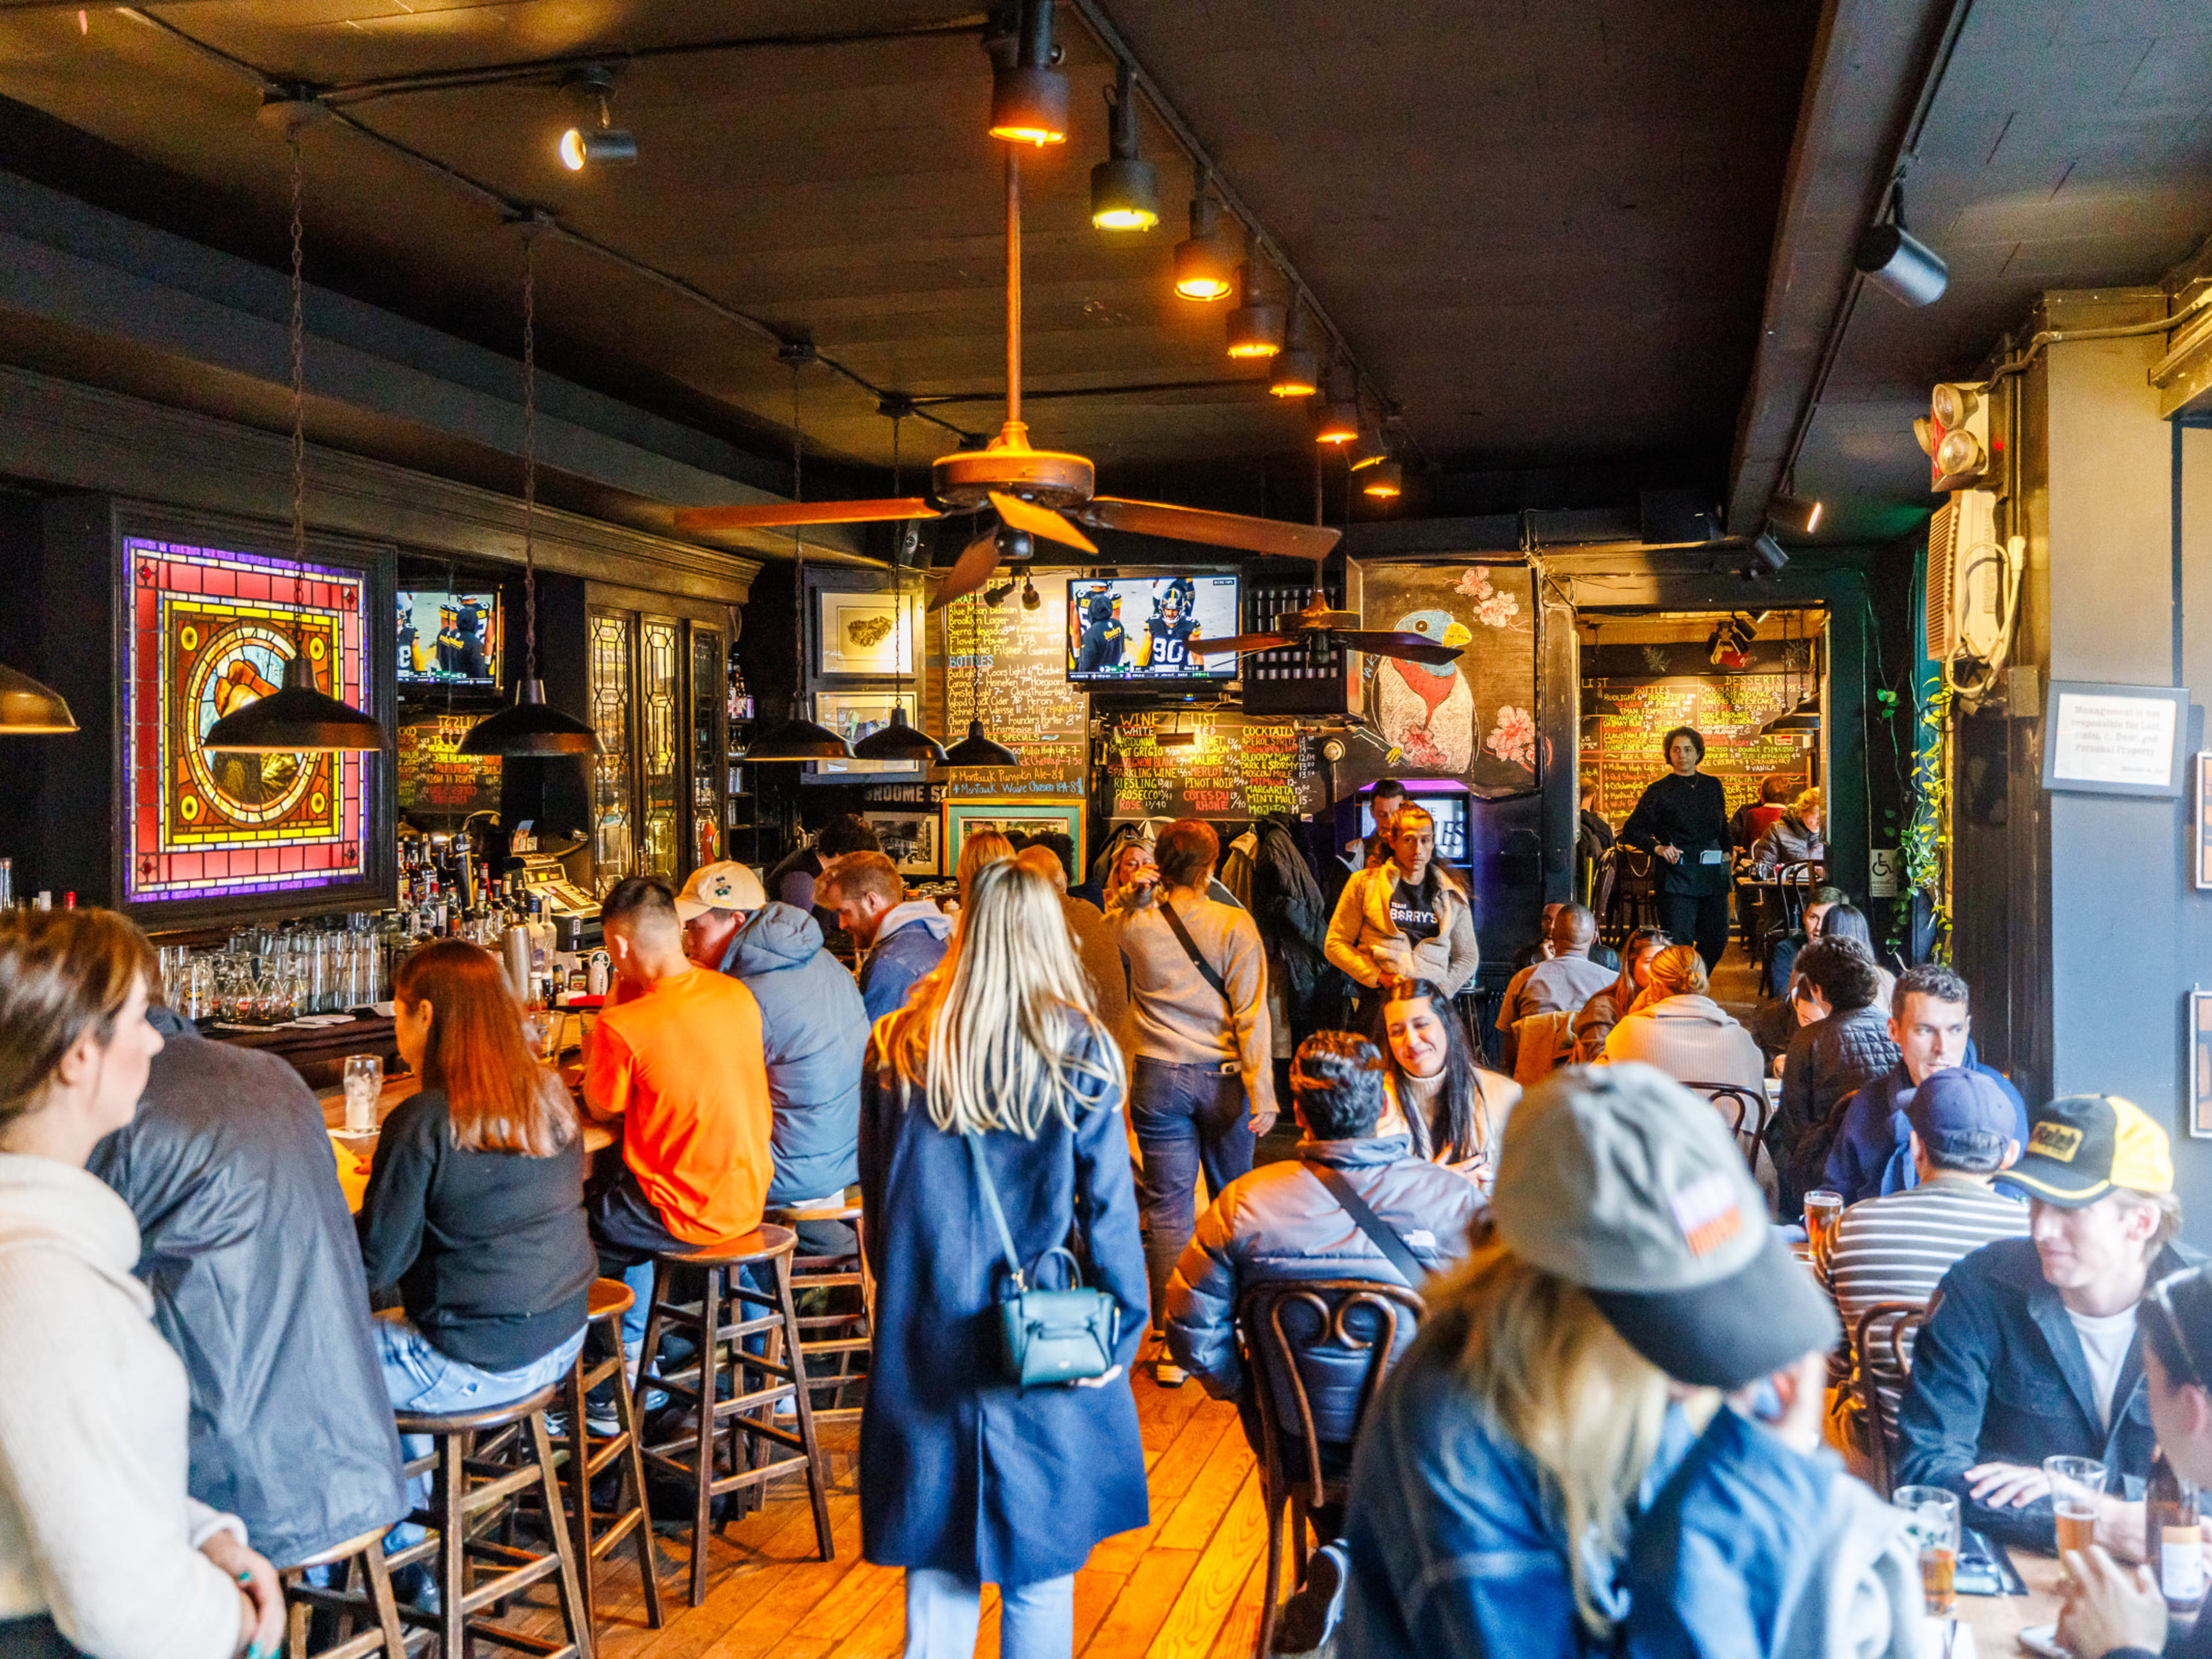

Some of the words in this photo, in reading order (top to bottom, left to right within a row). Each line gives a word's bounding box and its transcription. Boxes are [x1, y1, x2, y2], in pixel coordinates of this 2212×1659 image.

[984, 616, 1008, 627] Lager
[1018, 635, 1036, 645] IPA
[1153, 637, 1184, 663] 90
[949, 656, 994, 668] BOTTLES
[1724, 676, 1782, 685] DESSERTS
[1634, 686, 1671, 694] BOTTLES
[1119, 713, 1161, 726] WINE
[1190, 713, 1219, 726] LIST
[1123, 726, 1154, 736] WHITE
[1195, 726, 1217, 736] RED
[1243, 726, 1295, 737] COCKTAILS
[1109, 737, 1157, 747] CHARDONNA
[1241, 737, 1268, 746] APEROL
[1190, 755, 1225, 766] MALBEC
[1241, 753, 1272, 762] BLOODY
[1274, 753, 1296, 762] MARY
[1241, 761, 1259, 770] DARK
[1268, 761, 1299, 770] STORMY
[1107, 767, 1152, 778] SPARKLING
[1153, 767, 1177, 778] WINE
[1191, 766, 1224, 778] MERLOT
[1272, 770, 1293, 778] MULE
[1113, 778, 1157, 789] RIESLING
[1184, 778, 1210, 789] PINOT
[1213, 778, 1234, 788] NOIR
[1249, 778, 1285, 786] MIMOSA
[865, 784, 925, 802] BROOME
[1115, 790, 1158, 801] PROSECCO
[1216, 790, 1230, 801] DU
[1247, 794, 1274, 804] MINT
